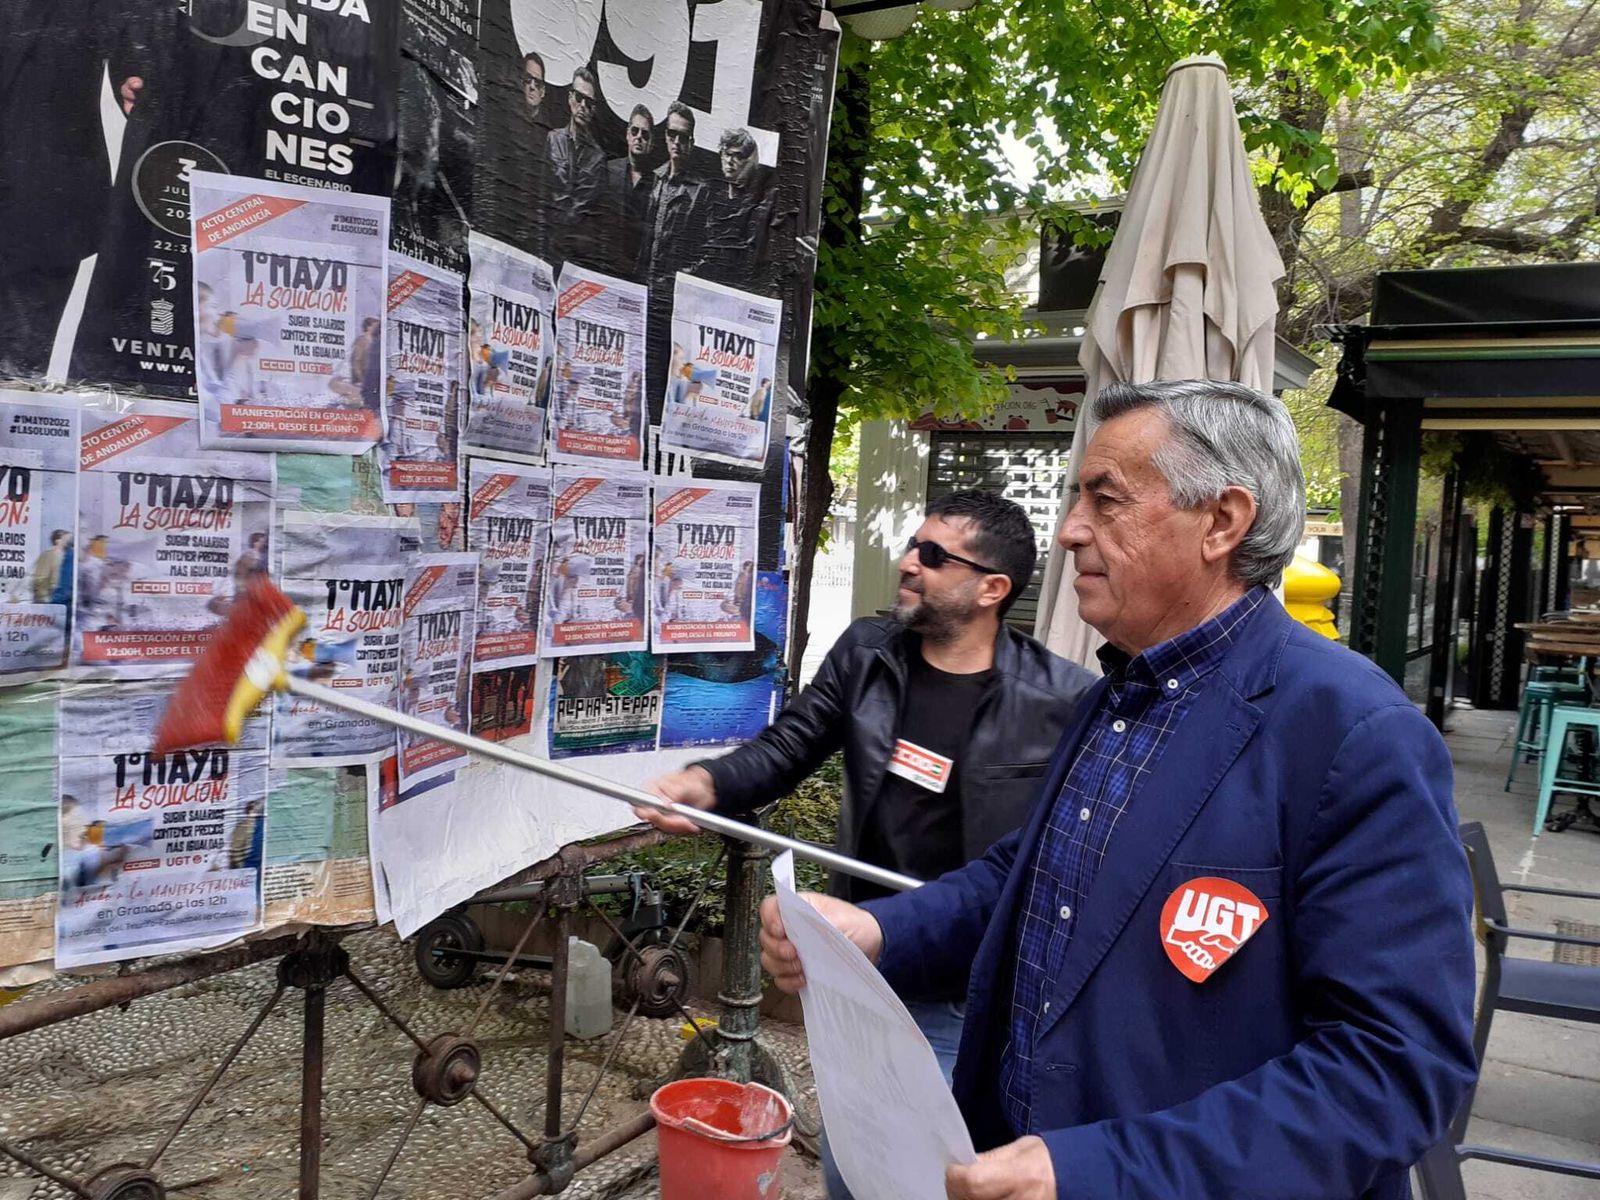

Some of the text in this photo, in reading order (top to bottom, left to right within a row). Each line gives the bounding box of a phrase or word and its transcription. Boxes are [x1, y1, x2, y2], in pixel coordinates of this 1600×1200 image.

[247, 1, 308, 45] EN
[251, 46, 348, 97] CAN
[510, 0, 780, 168] 091
[270, 92, 350, 134] CIO
[265, 129, 354, 175] NES
[164, 186, 188, 197] JUL
[265, 169, 352, 193] EL ESCENARIO
[166, 207, 192, 220] 202
[201, 197, 265, 231] ACTO CENTRAL
[207, 208, 273, 243] DE ANDALUCÍA
[154, 240, 191, 254] 22:3
[149, 260, 177, 291] 75
[140, 361, 193, 375] www.
[13, 414, 71, 428] #1MAYO2022
[278, 421, 308, 432] DESDE
[309, 410, 321, 419] EN
[80, 416, 145, 451] CTO CENTRAL
[81, 426, 153, 466] DE ANDALUCÍA
[112, 502, 141, 530] LA
[132, 583, 200, 593] CCOO UGT
[321, 607, 344, 632] LA
[95, 632, 182, 644] MANIFESTACIÓN
[182, 633, 196, 642] EN
[146, 645, 180, 656] DESDE
[180, 645, 192, 655] EL
[325, 718, 371, 729] Granada
[109, 783, 136, 813] LA
[166, 855, 191, 868] UGT
[96, 894, 228, 920] en Granada a las 12h
[1174, 888, 1260, 944] UGT
